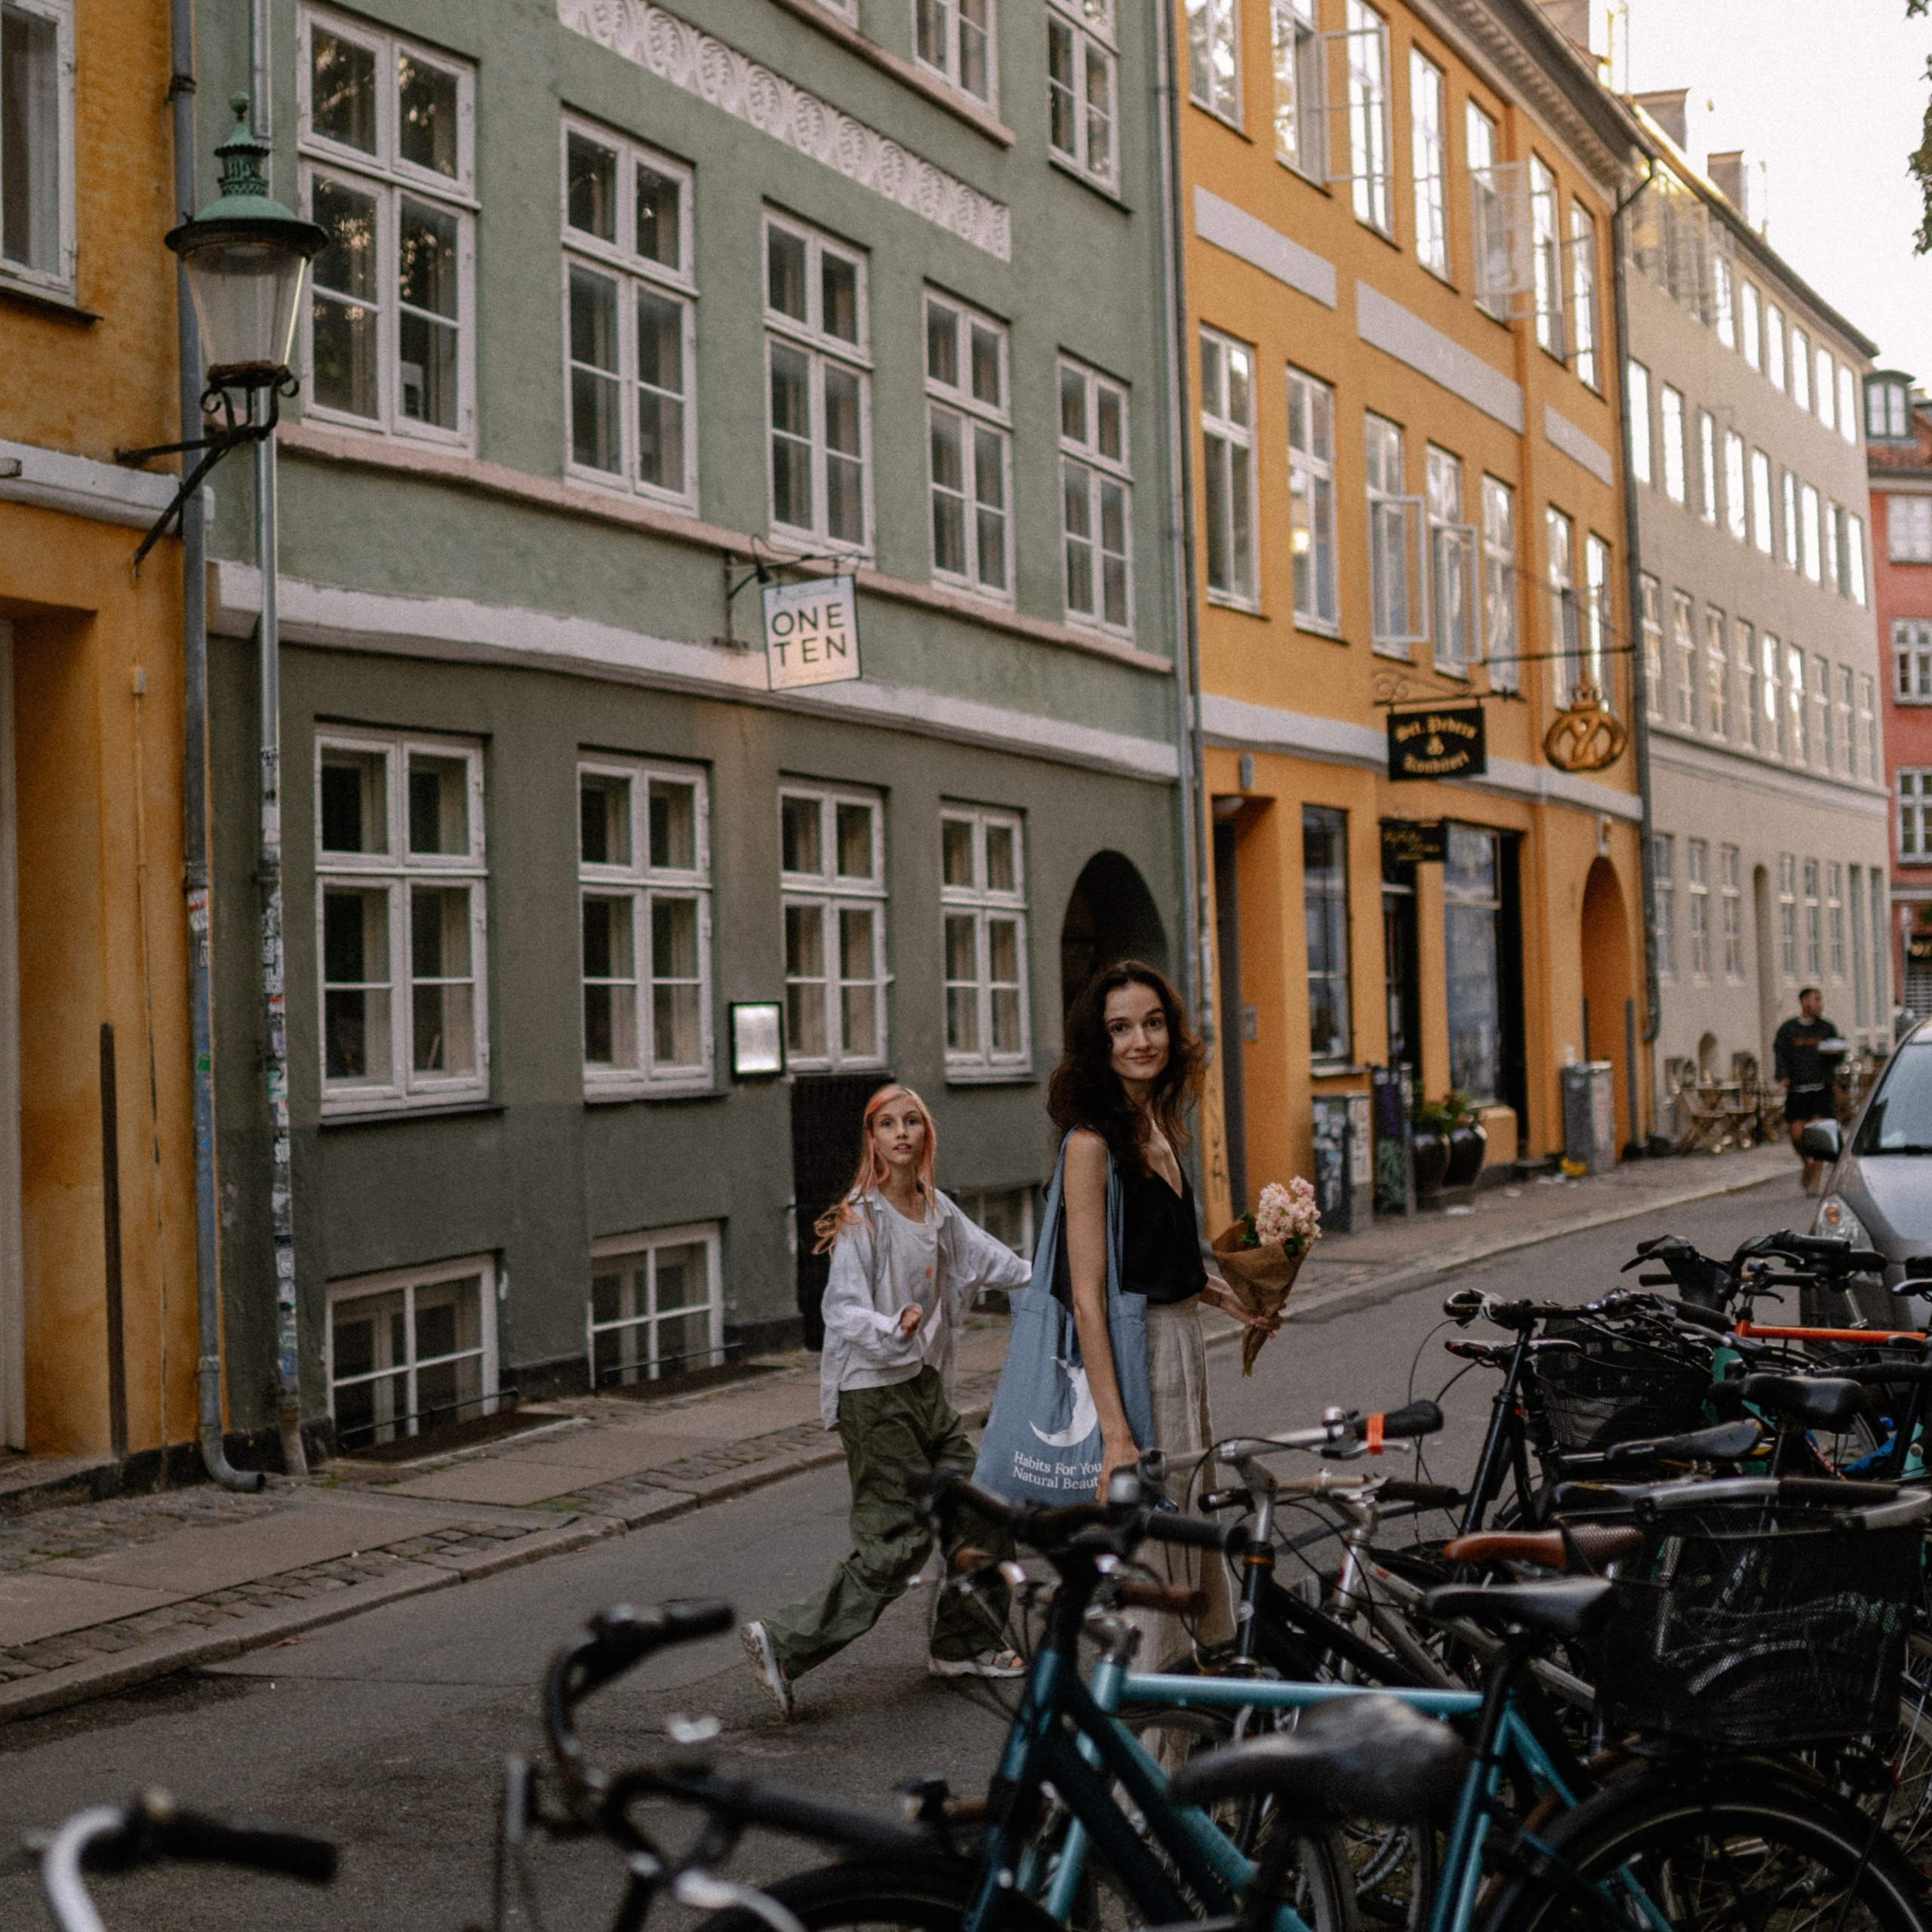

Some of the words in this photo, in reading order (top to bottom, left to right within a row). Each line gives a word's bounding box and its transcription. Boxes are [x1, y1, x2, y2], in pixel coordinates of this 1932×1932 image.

[771, 602, 844, 637] ONE
[773, 632, 847, 667] TEN
[1013, 1465, 1058, 1488] Natural
[1063, 1476, 1099, 1490] Beaut
[1014, 1451, 1051, 1473] Habits
[1055, 1462, 1076, 1475] For
[1079, 1462, 1102, 1475] You
